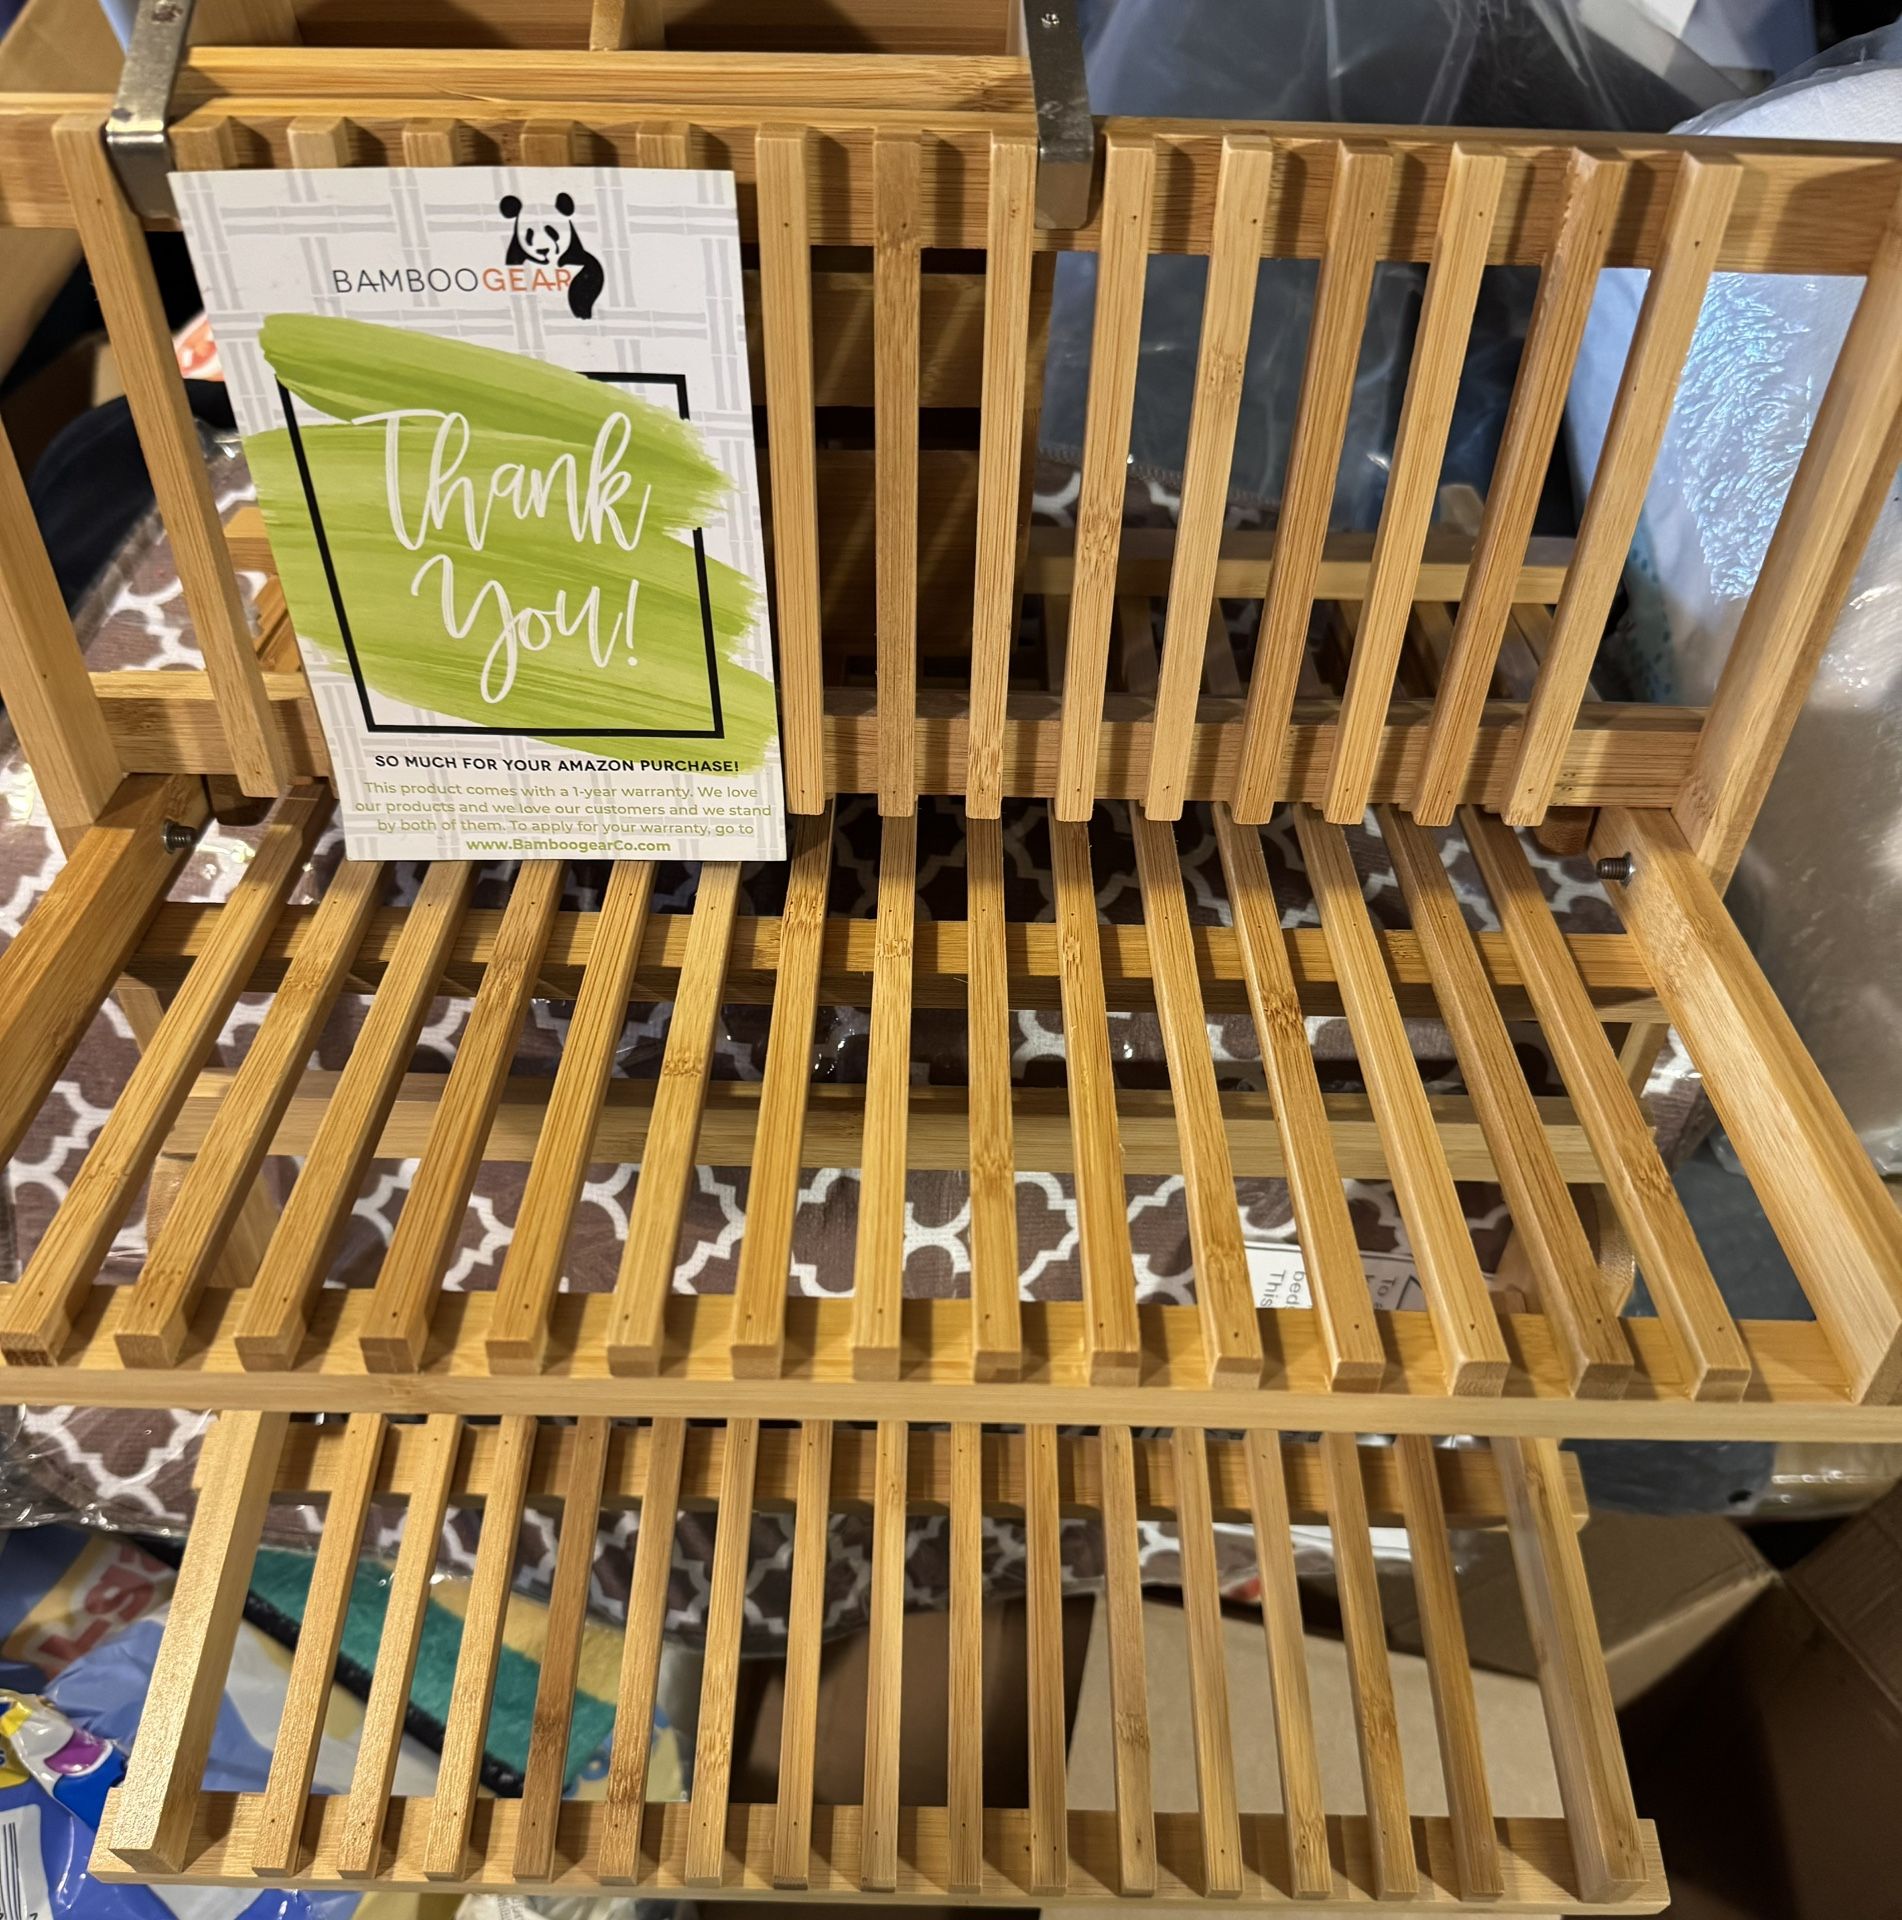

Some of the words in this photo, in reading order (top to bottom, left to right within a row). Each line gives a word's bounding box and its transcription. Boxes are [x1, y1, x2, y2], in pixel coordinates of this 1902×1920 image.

[351, 408, 652, 551] Thank
[410, 553, 640, 704] You!
[375, 755, 399, 767] SO
[405, 756, 458, 769] MUCH
[463, 757, 498, 770] FOR
[502, 759, 552, 771] YOUR
[557, 760, 635, 772] AMAZON
[640, 760, 740, 772] PURCHASE!
[364, 781, 397, 794] This
[401, 782, 462, 796] product
[466, 786, 518, 796] comes
[520, 785, 556, 797] with
[560, 788, 569, 797] a
[572, 787, 617, 799] 1-year
[621, 788, 694, 800] warranty.
[697, 786, 723, 798] We
[727, 786, 758, 798] love
[355, 802, 381, 812] our
[386, 801, 455, 814] products
[459, 801, 489, 813] and
[492, 804, 518, 813] we
[520, 802, 551, 814] love
[554, 805, 581, 815] our
[585, 805, 666, 816] customers
[669, 804, 698, 816] and
[702, 806, 726, 816] we
[729, 804, 772, 817] stand
[377, 819, 397, 833] by
[401, 819, 437, 831] both
[441, 819, 458, 831] of
[460, 820, 506, 832] them.
[509, 820, 527, 832] To
[531, 820, 574, 835] apply
[577, 821, 599, 833] for
[602, 823, 636, 835] your
[640, 823, 712, 836] warranty,
[715, 825, 735, 837] go
[738, 824, 754, 835] to
[466, 838, 671, 853] www.BamboogearCo.com
[1260, 1270, 1287, 1308] This
